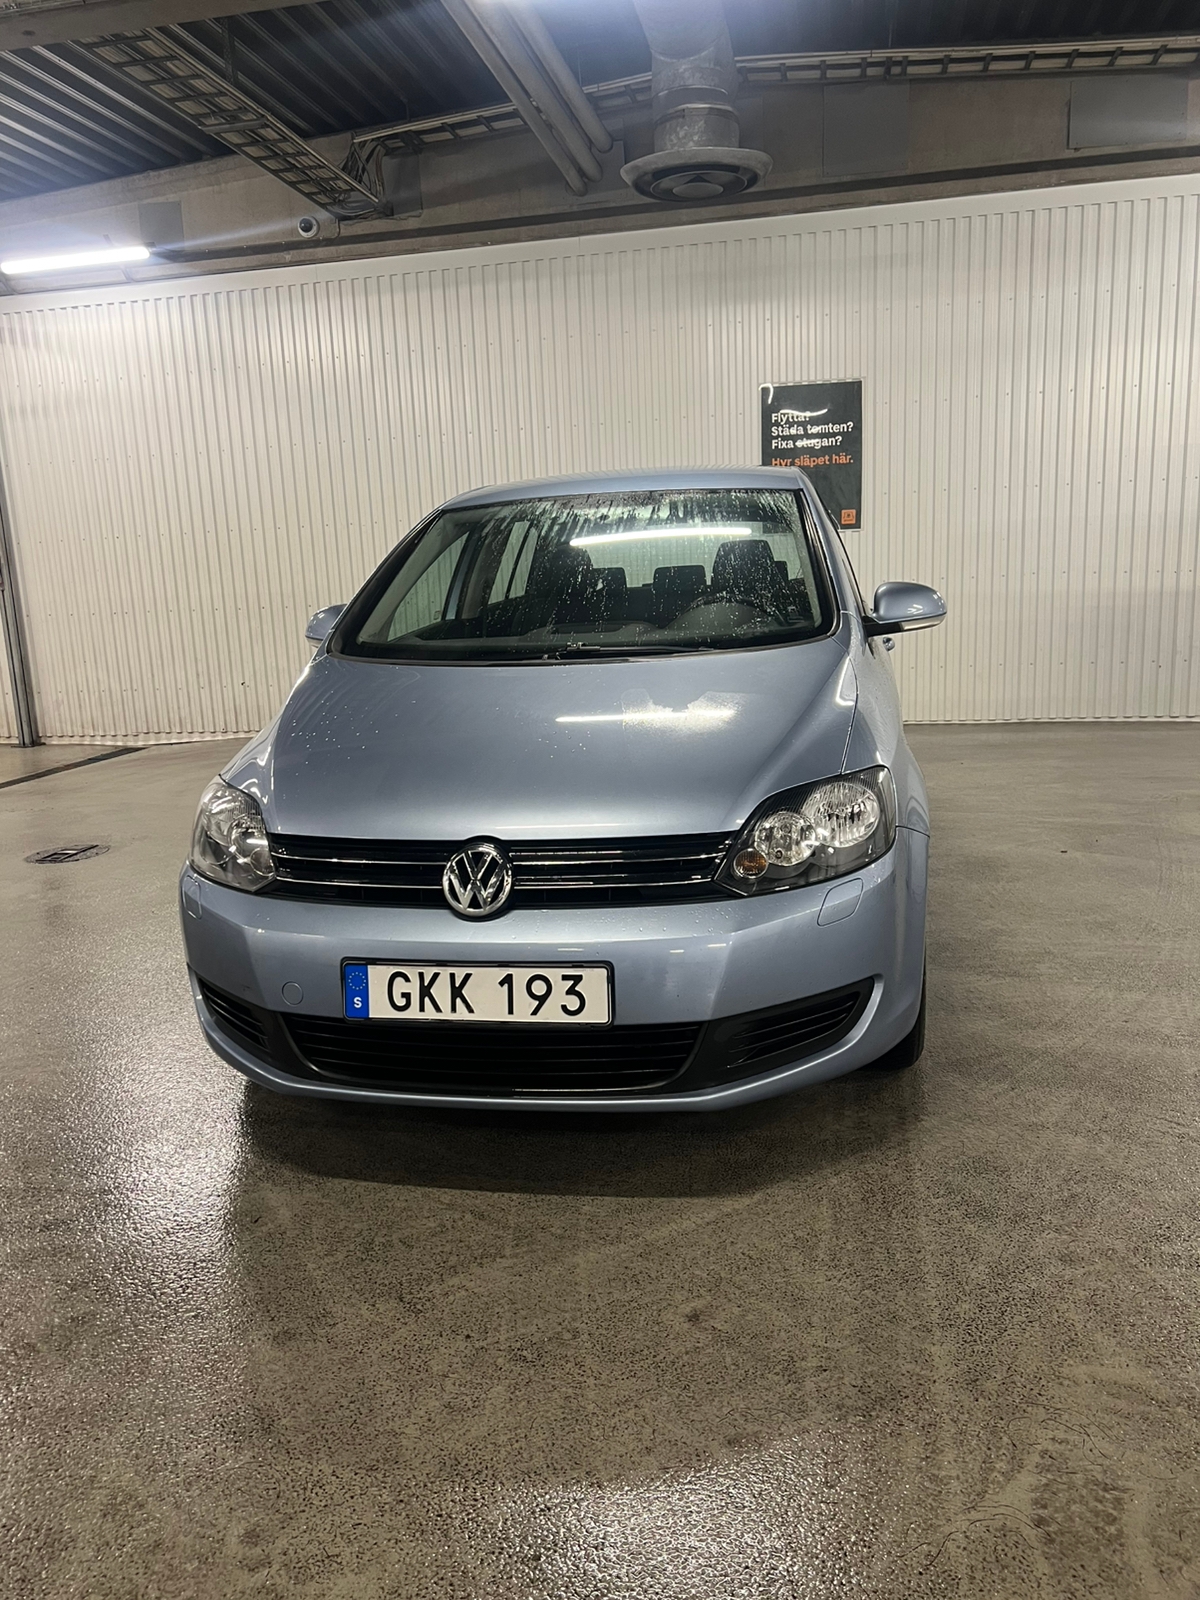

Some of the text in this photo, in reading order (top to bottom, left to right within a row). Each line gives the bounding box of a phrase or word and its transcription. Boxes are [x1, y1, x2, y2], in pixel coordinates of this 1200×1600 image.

[771, 421, 854, 437] Städa tomten?
[771, 438, 794, 450] Fixa
[772, 453, 854, 468] Hyr släpet här.
[387, 970, 587, 1017] GKK 193
[353, 996, 363, 1009] S
